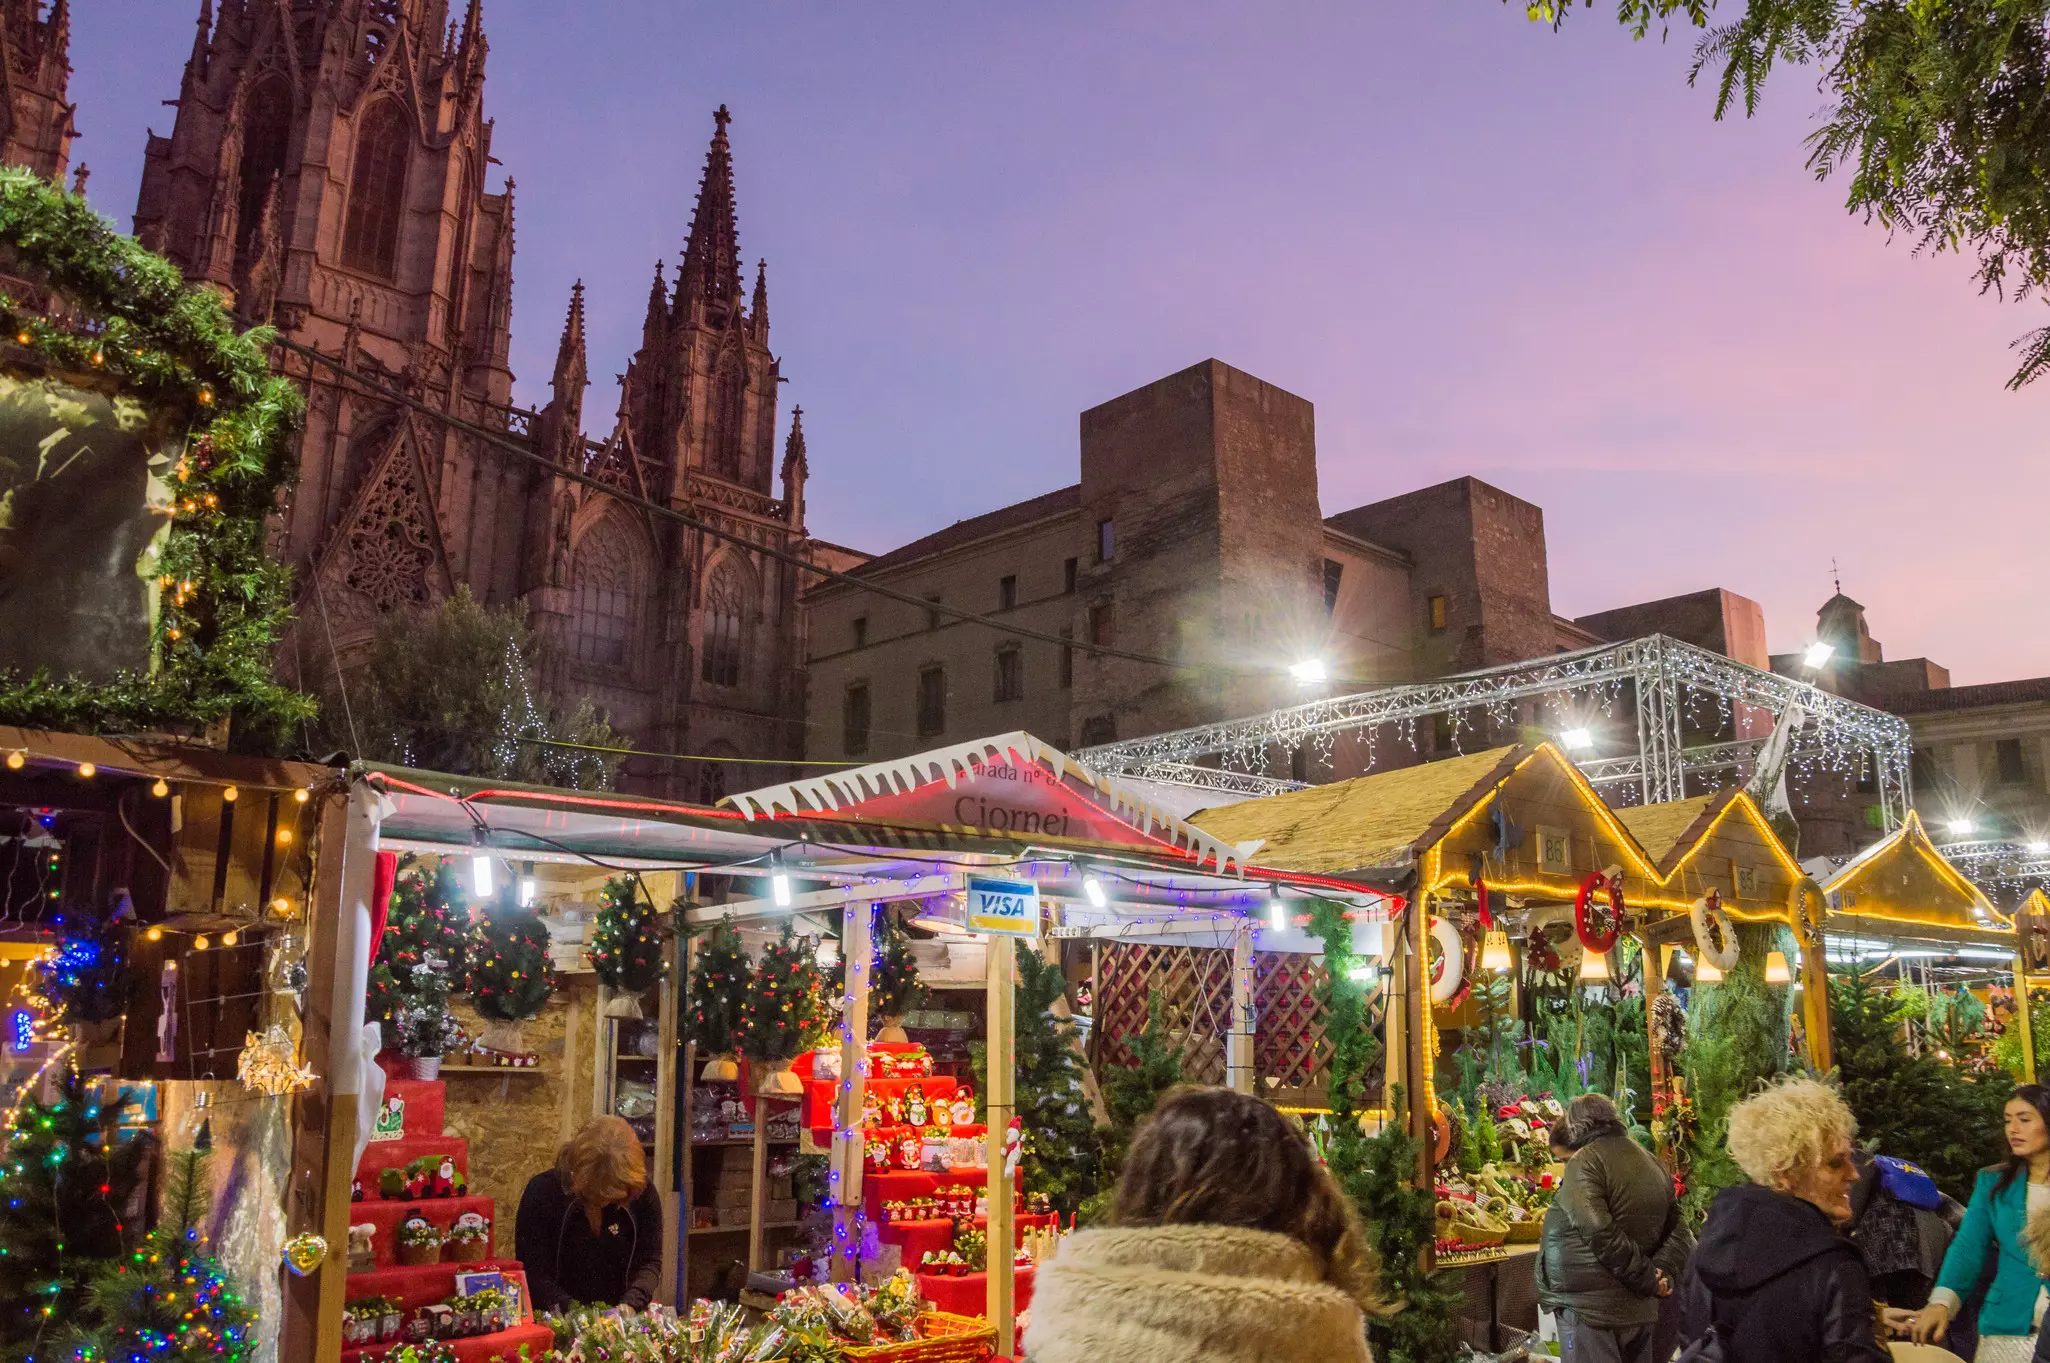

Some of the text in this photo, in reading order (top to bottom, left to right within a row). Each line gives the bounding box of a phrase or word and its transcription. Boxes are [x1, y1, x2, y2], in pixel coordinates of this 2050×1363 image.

[954, 796, 1070, 837] Ciornei
[1546, 839, 1563, 863] 86
[1739, 871, 1753, 890] 85
[980, 894, 1025, 916] VISA
